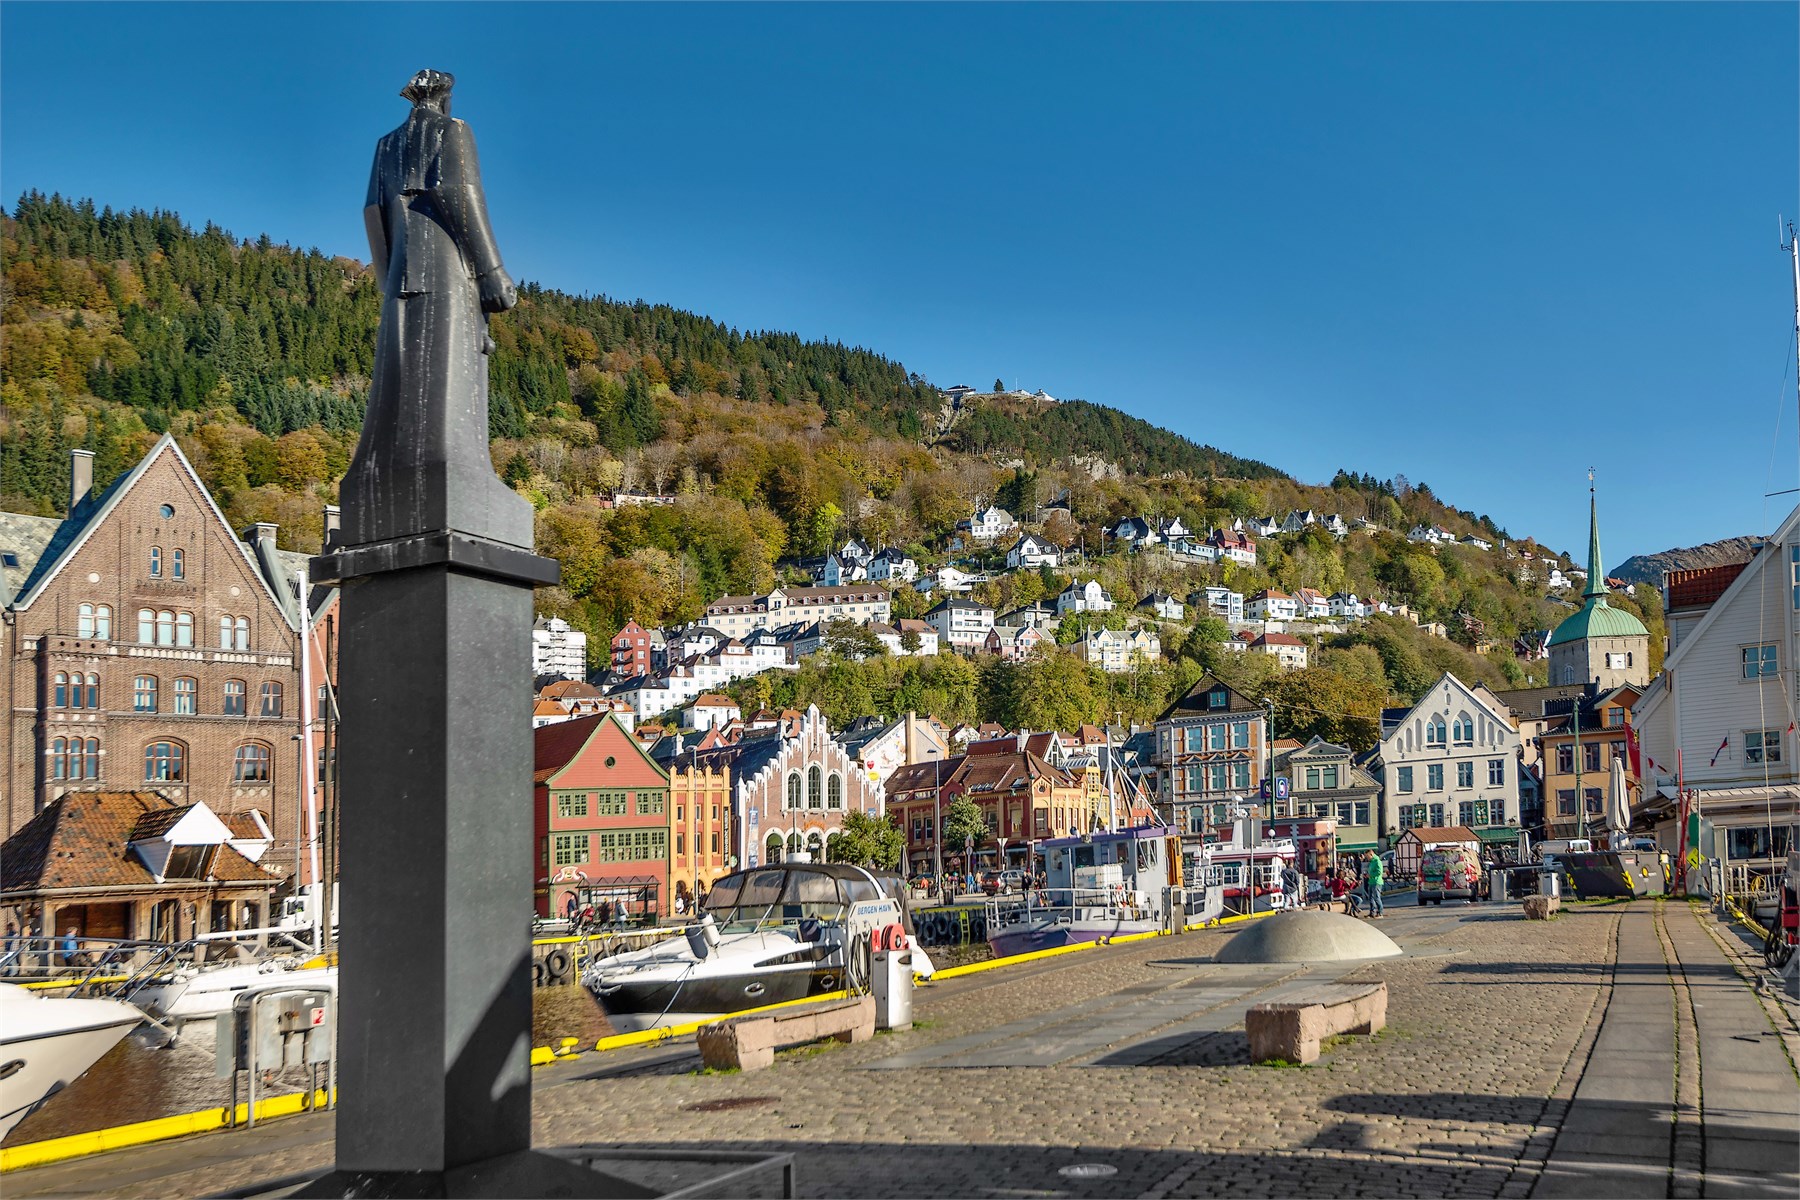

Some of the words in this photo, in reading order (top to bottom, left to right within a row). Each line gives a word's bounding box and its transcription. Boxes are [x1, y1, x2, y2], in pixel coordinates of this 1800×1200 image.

[864, 748, 876, 758] Come
[883, 734, 892, 744] play
[858, 906, 878, 915] BERGEN
